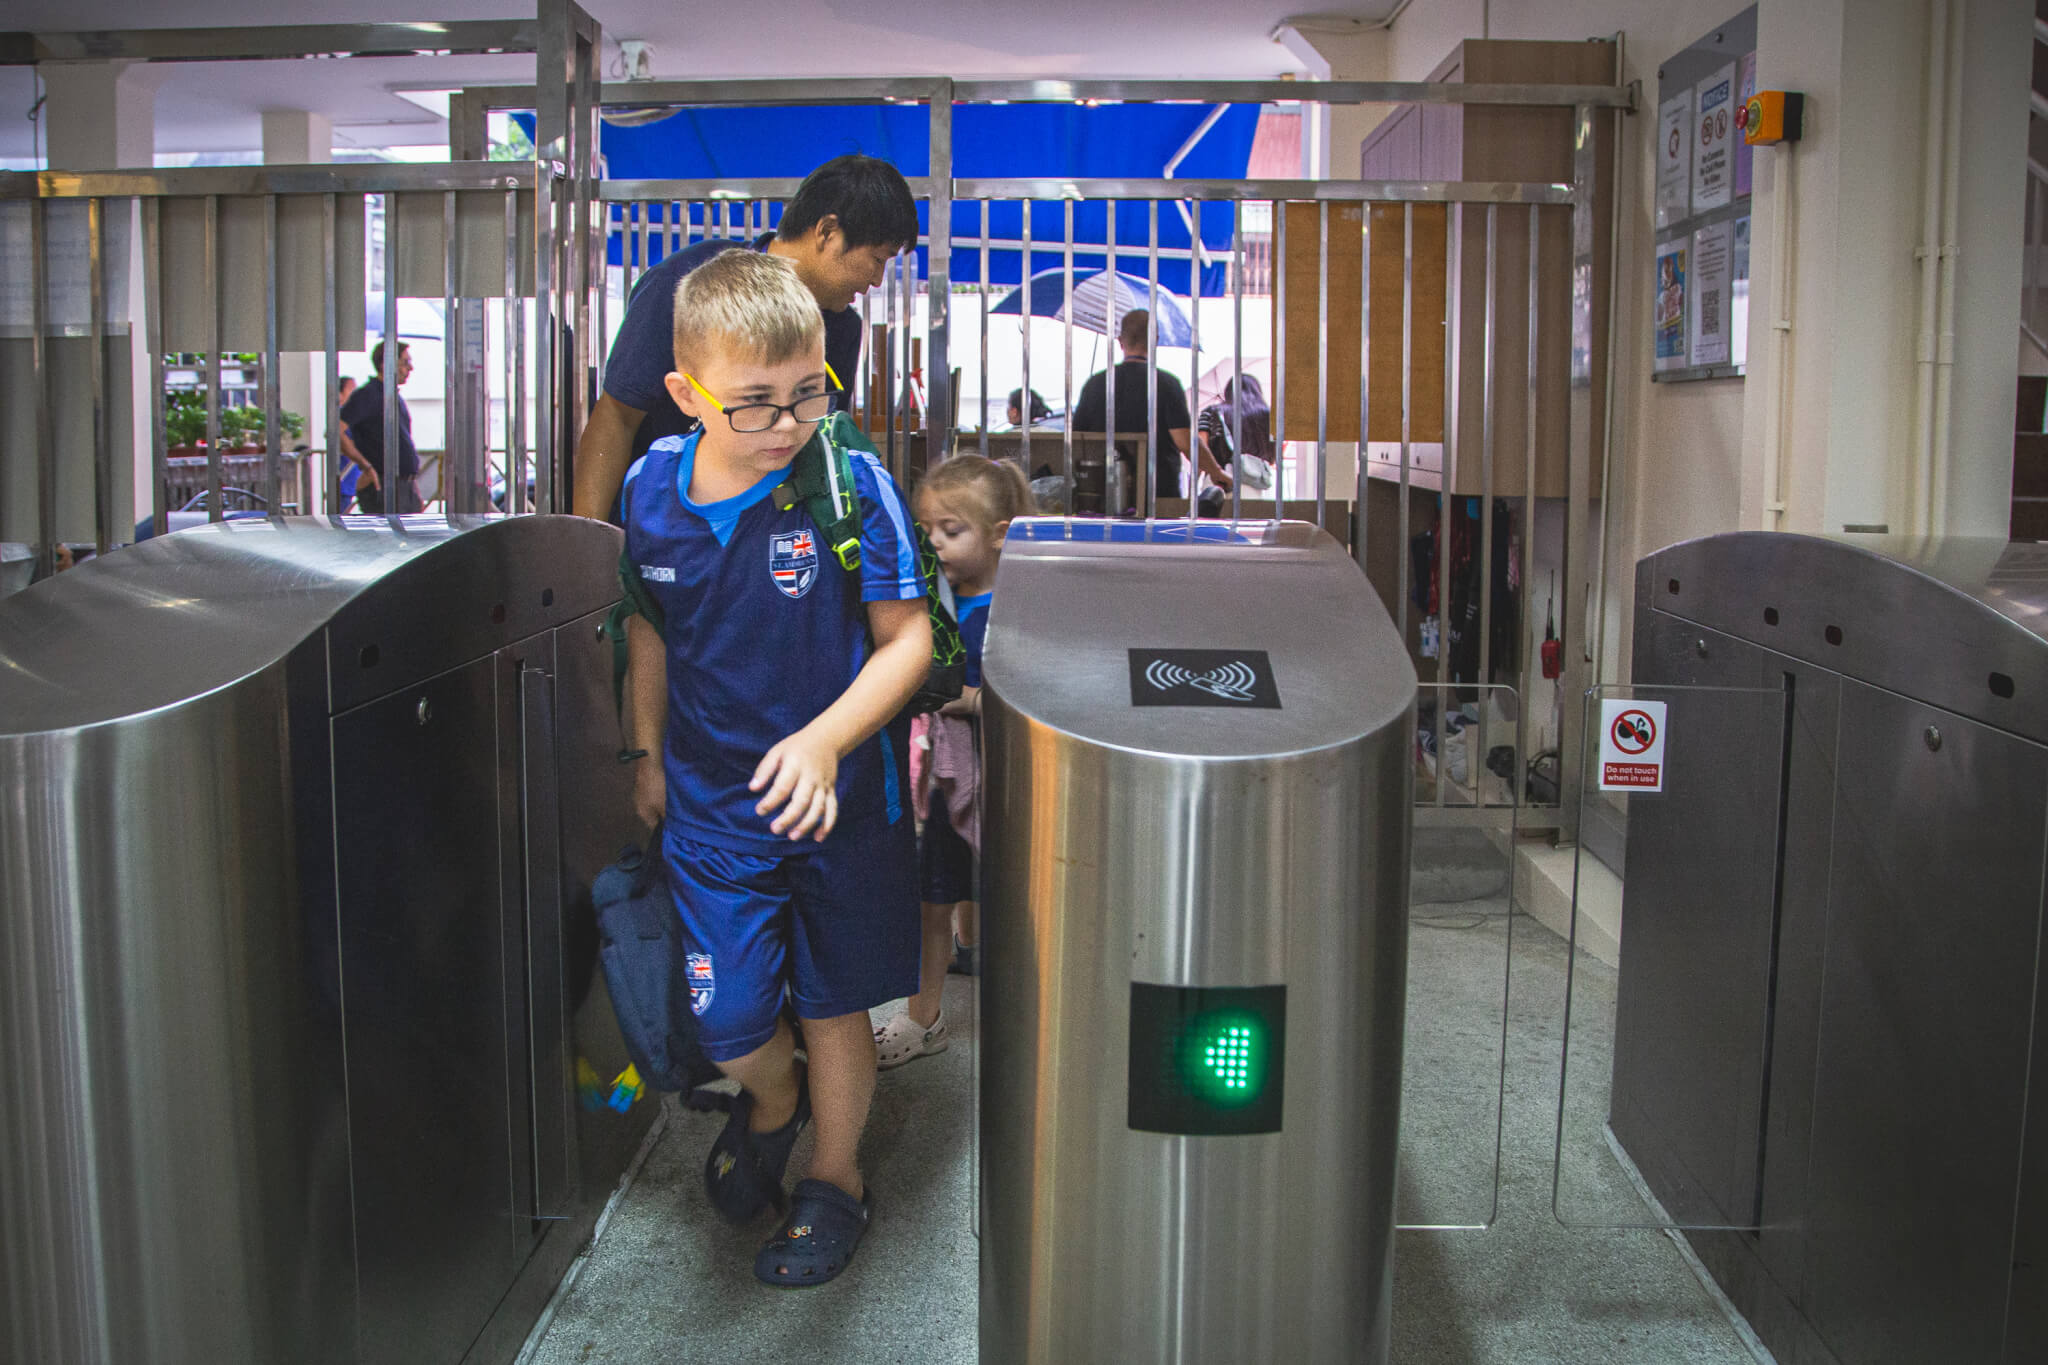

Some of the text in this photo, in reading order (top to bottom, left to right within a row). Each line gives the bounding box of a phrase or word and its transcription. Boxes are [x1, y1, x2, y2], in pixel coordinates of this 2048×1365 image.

[1606, 765, 1618, 773] Do
[1634, 766, 1657, 775] touch
[1607, 774, 1629, 782] when
[1630, 774, 1638, 782] in
